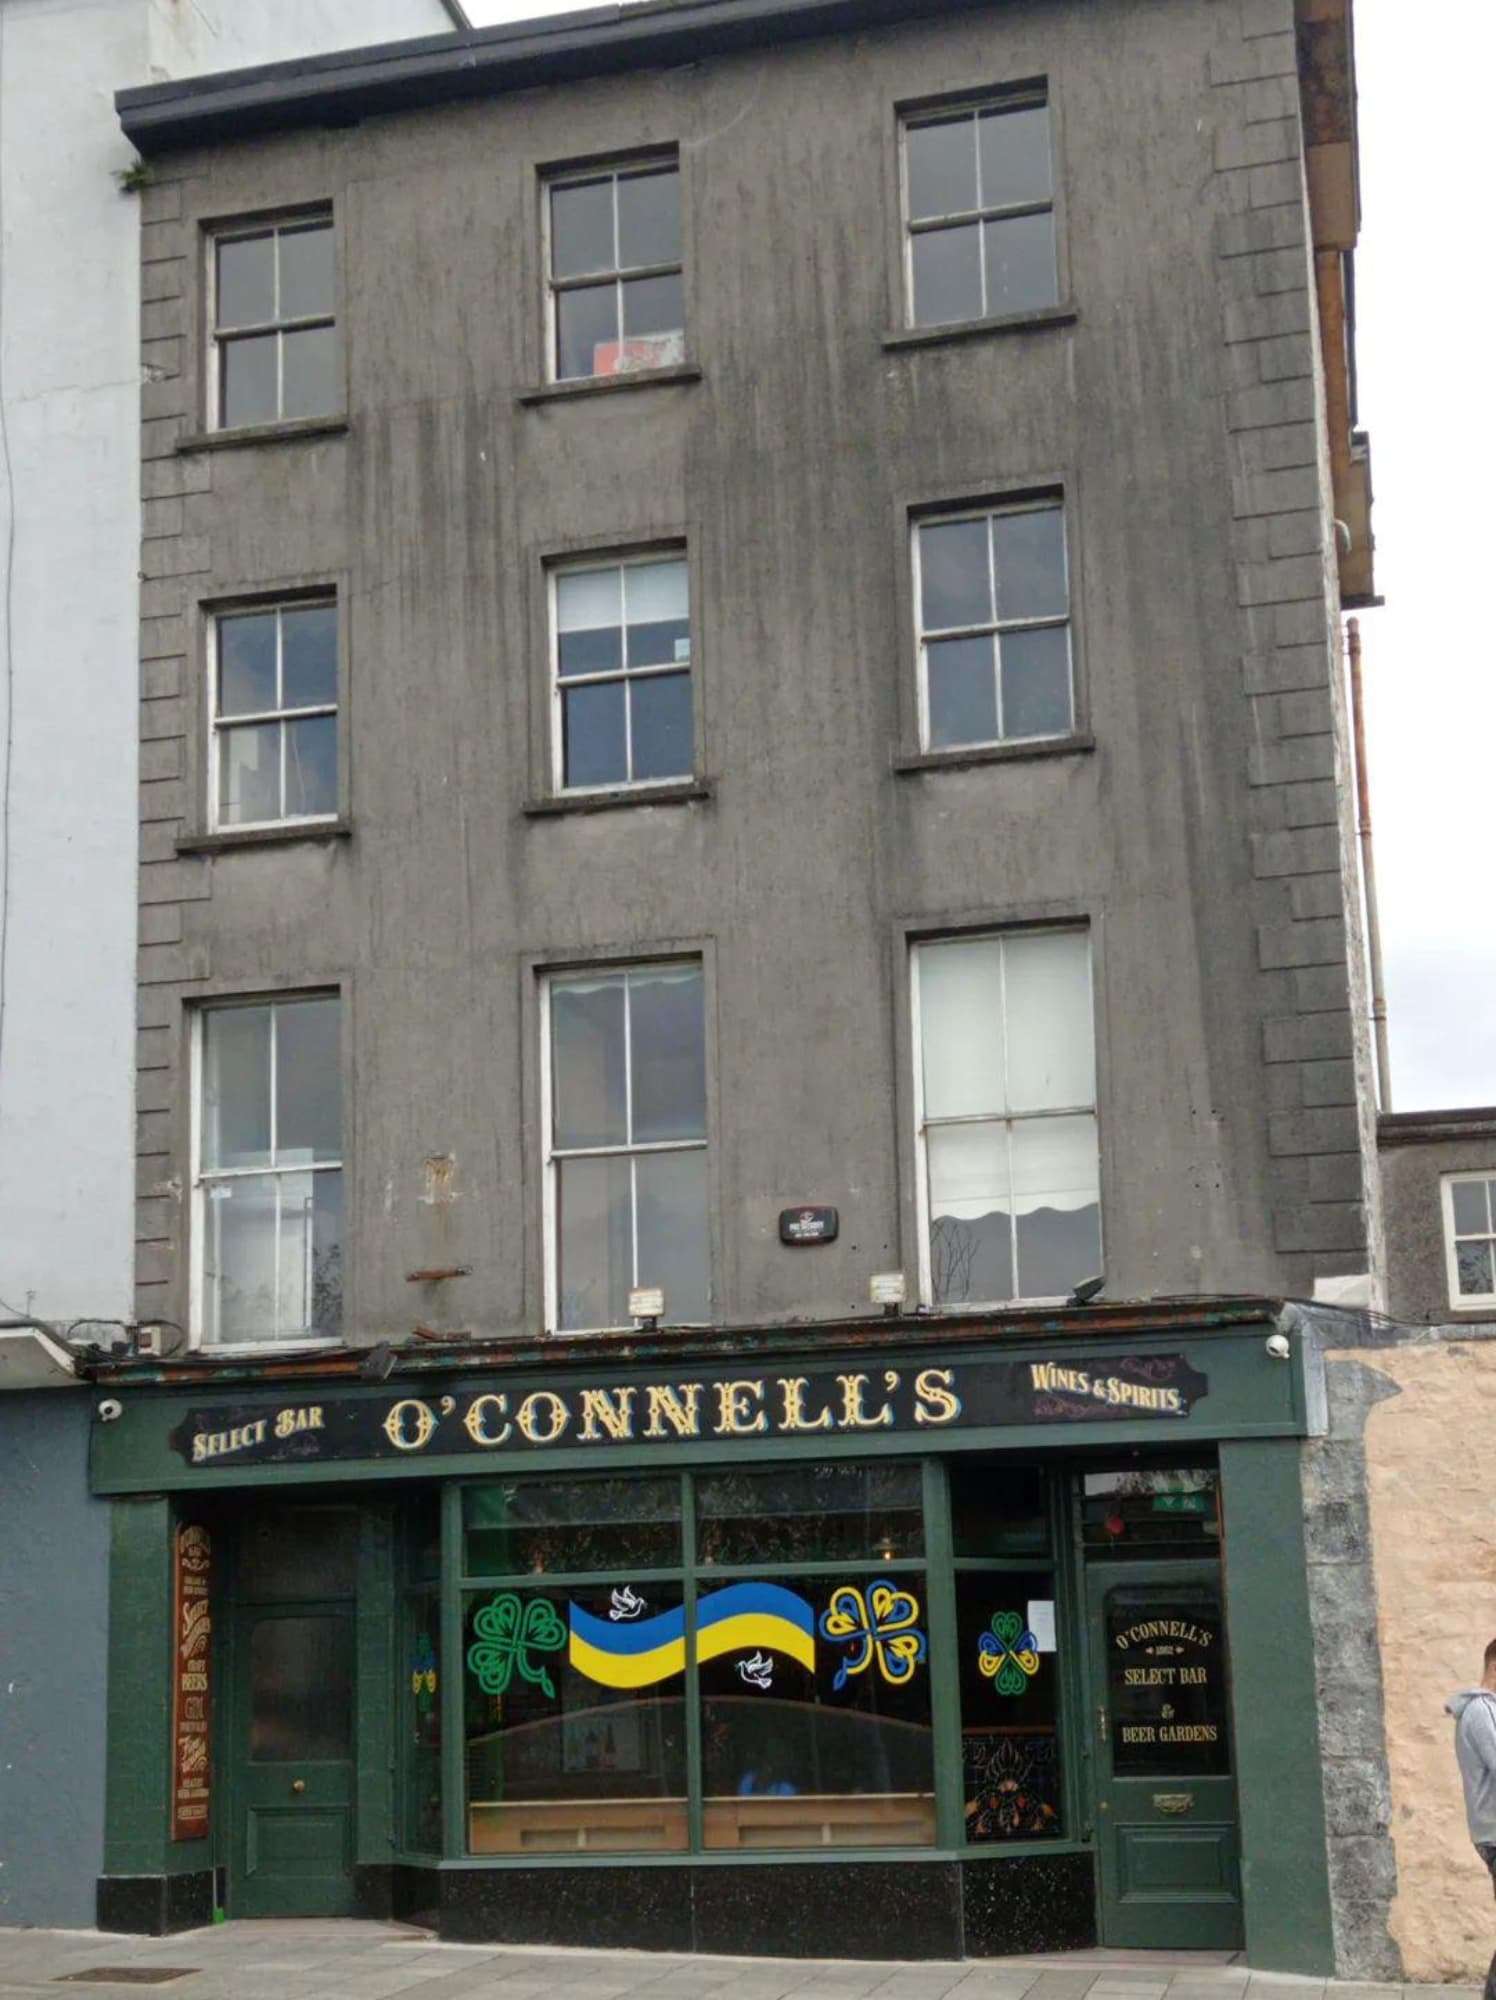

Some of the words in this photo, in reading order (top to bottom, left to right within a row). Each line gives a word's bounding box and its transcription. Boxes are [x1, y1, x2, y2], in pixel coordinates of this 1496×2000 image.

[1029, 1362, 1089, 1394] WINES
[1093, 1378, 1107, 1400] &
[1106, 1376, 1181, 1412] SPIRITS
[382, 1368, 963, 1451] O'CONNELL'S
[192, 1418, 268, 1463] SELECT
[274, 1406, 326, 1438] BAR
[1115, 1620, 1213, 1650] O'CONNELL'S
[1124, 1668, 1176, 1686] SELECT
[1179, 1667, 1208, 1685] BAR
[1161, 1703, 1175, 1720] &
[1122, 1726, 1156, 1743] BEER
[1158, 1725, 1218, 1743] GARDENS
